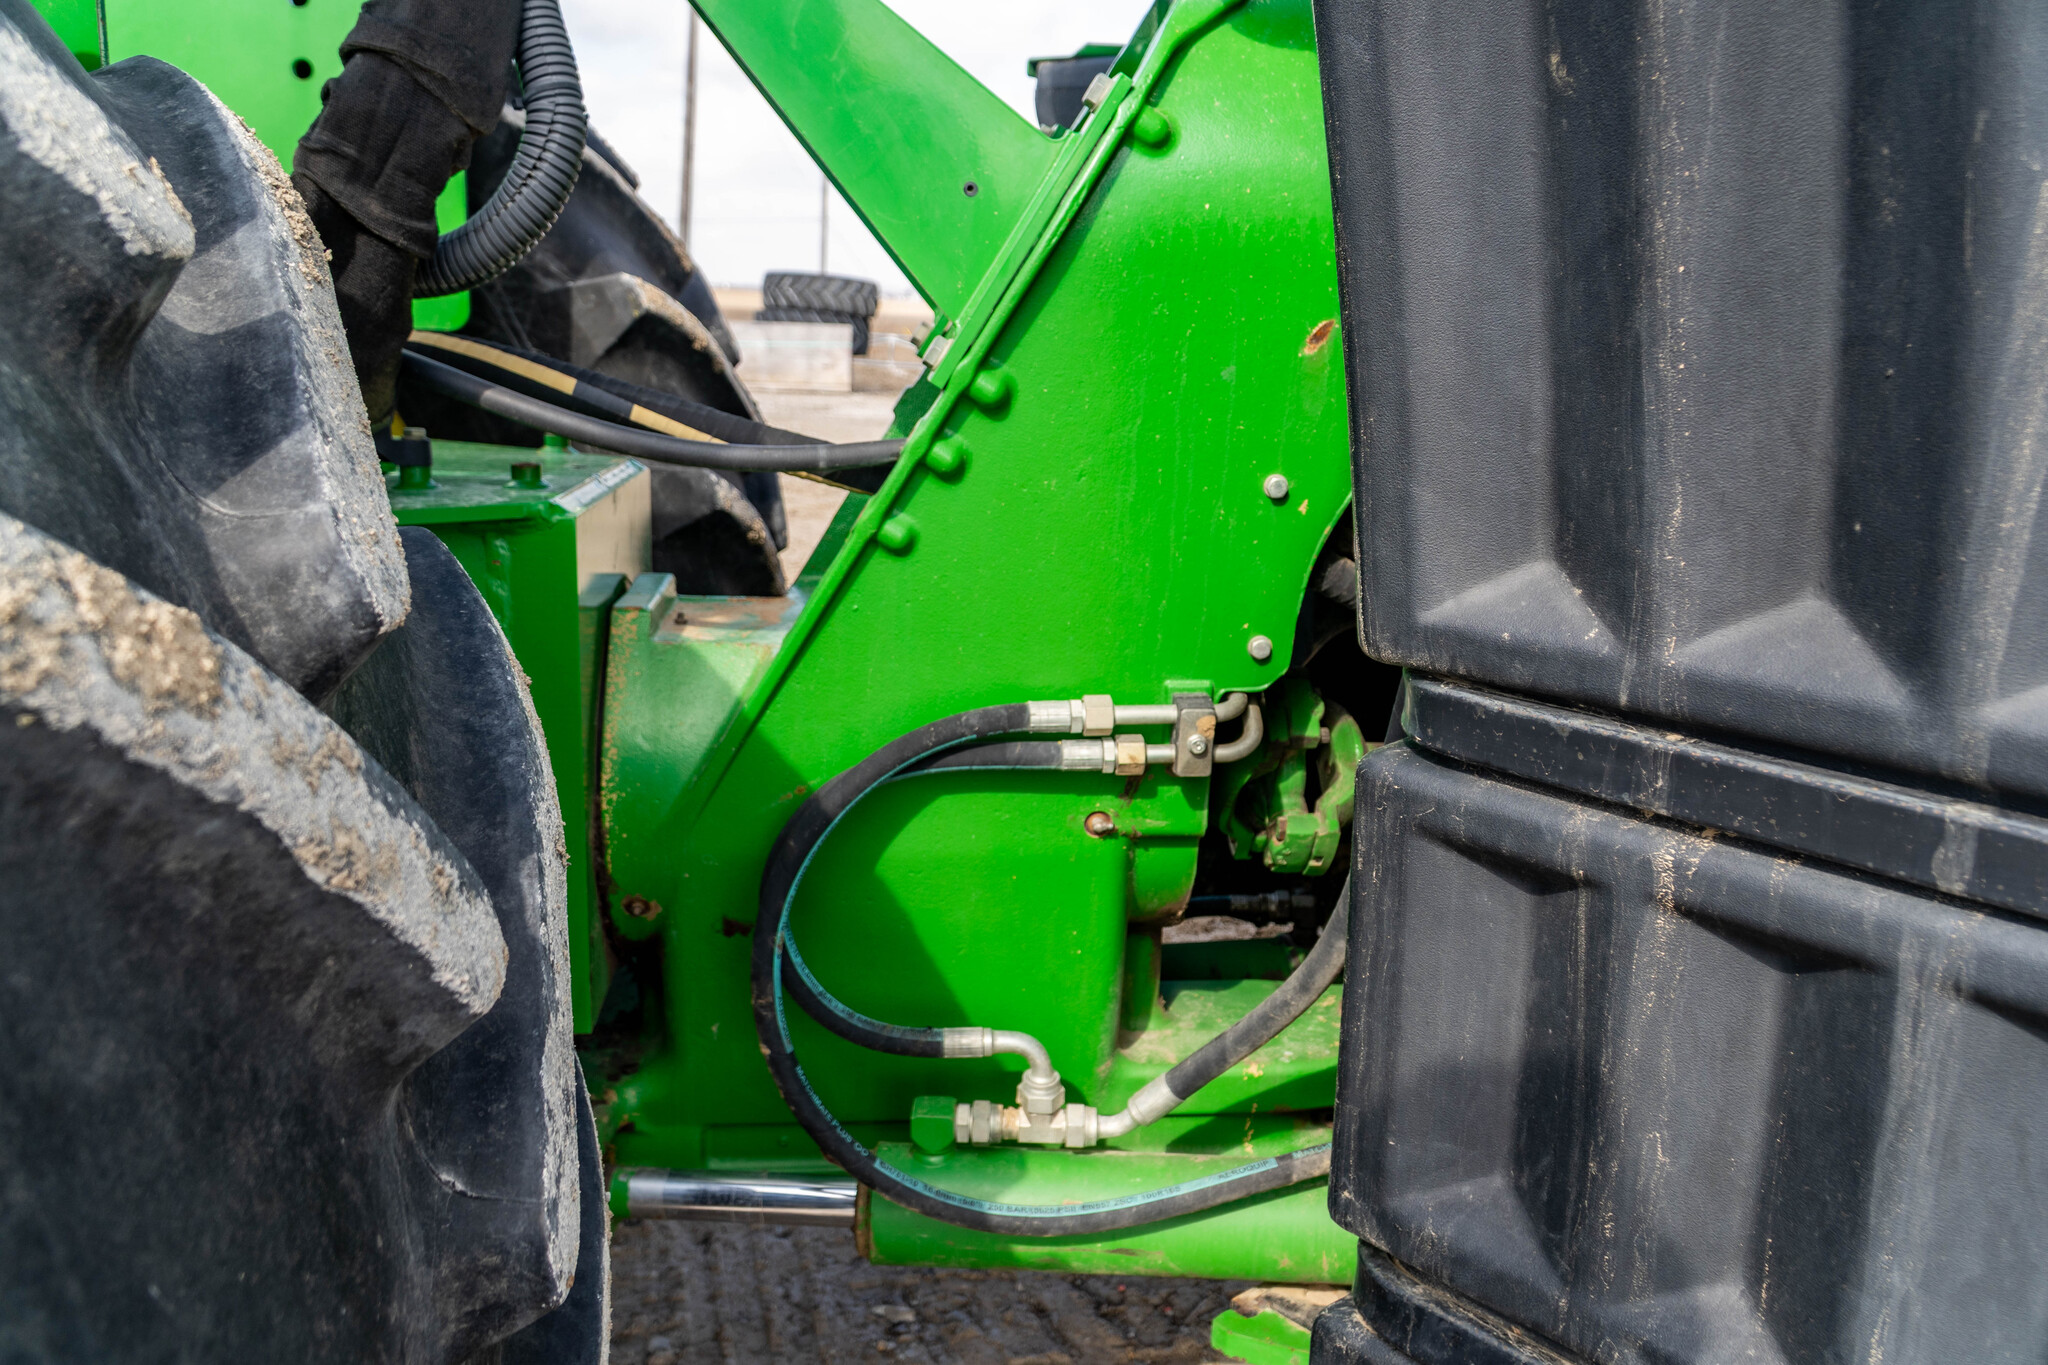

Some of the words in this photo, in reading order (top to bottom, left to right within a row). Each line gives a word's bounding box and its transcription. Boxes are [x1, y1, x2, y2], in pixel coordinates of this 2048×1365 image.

[796, 1065, 833, 1122] MATCHMATE
[832, 1119, 852, 1143] PLUS
[1218, 1159, 1270, 1181] AEROQUIP
